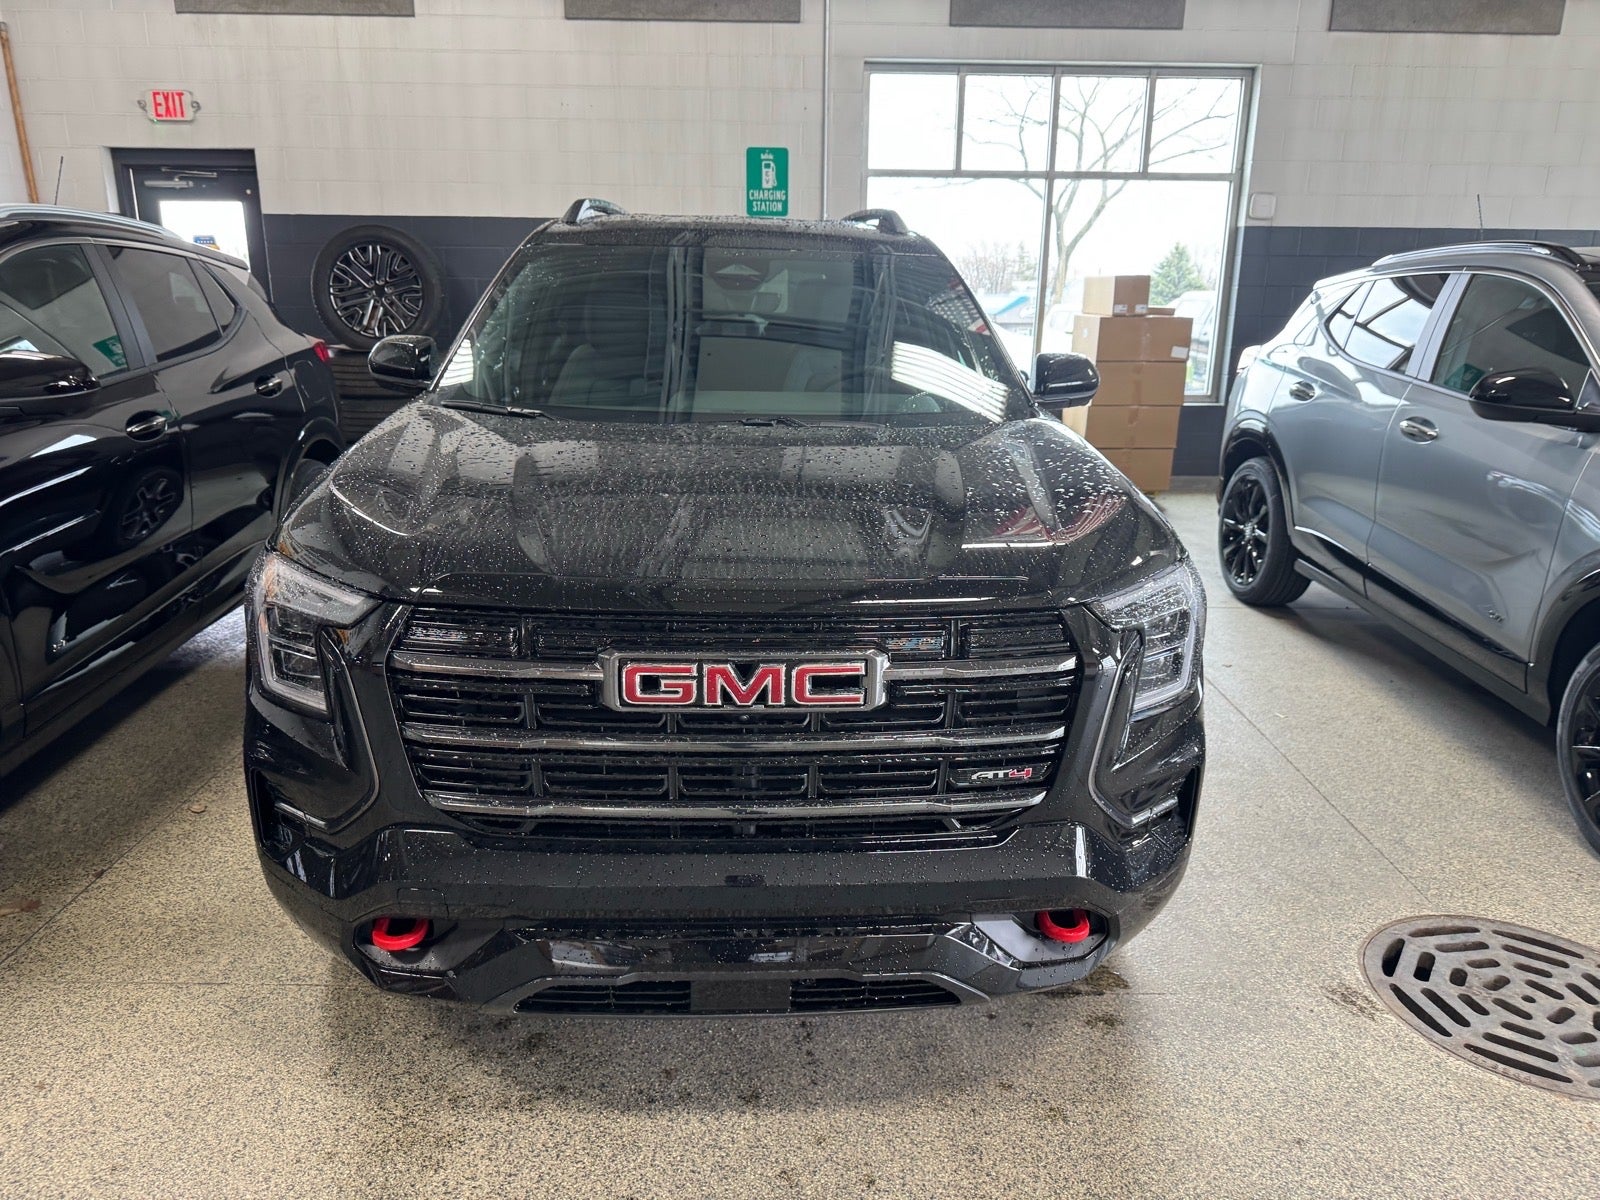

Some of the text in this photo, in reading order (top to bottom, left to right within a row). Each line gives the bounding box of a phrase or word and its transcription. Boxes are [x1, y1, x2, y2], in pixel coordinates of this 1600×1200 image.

[152, 91, 184, 118] EXIT
[749, 189, 786, 201] CHARGING
[752, 201, 783, 212] STATION
[623, 663, 865, 705] GMC
[971, 768, 1032, 780] AT4
